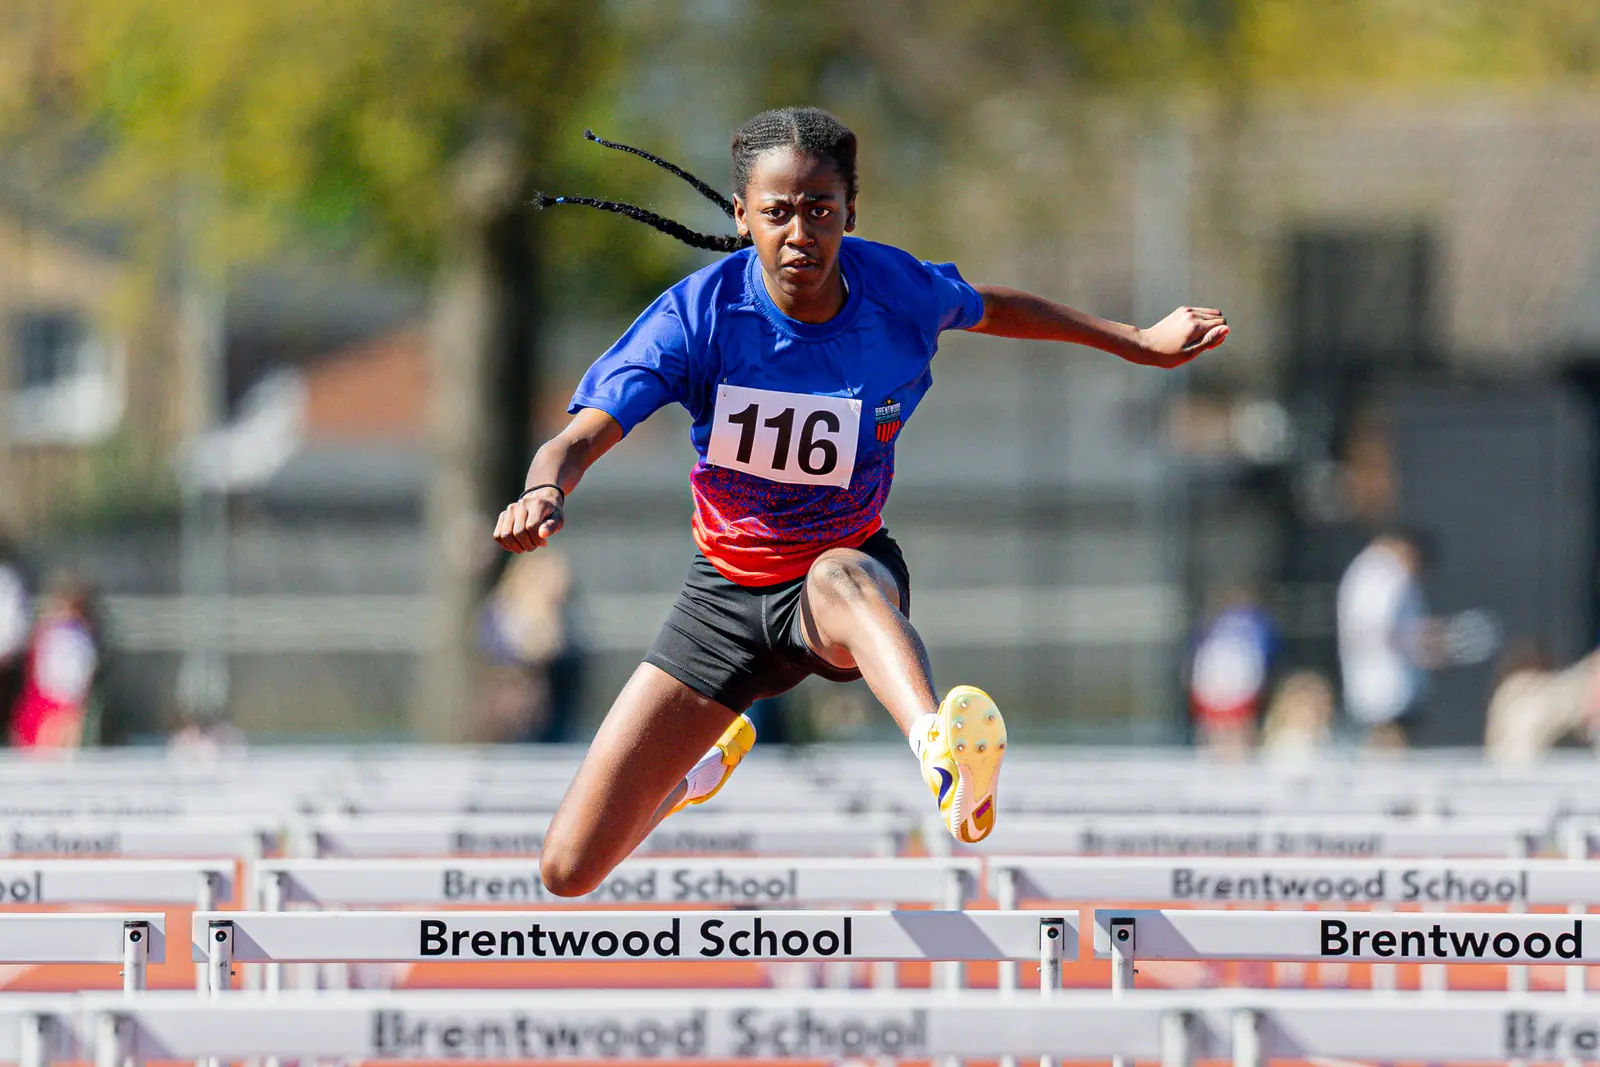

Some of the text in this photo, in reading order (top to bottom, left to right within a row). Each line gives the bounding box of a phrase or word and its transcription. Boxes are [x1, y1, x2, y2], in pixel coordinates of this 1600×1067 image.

[728, 403, 841, 476] 116
[673, 869, 797, 900] School
[1172, 868, 1528, 901] Brentwood School
[420, 917, 852, 957] Brentwood School
[1320, 919, 1583, 959] Brentwood
[372, 1008, 926, 1056] Brentwood School
